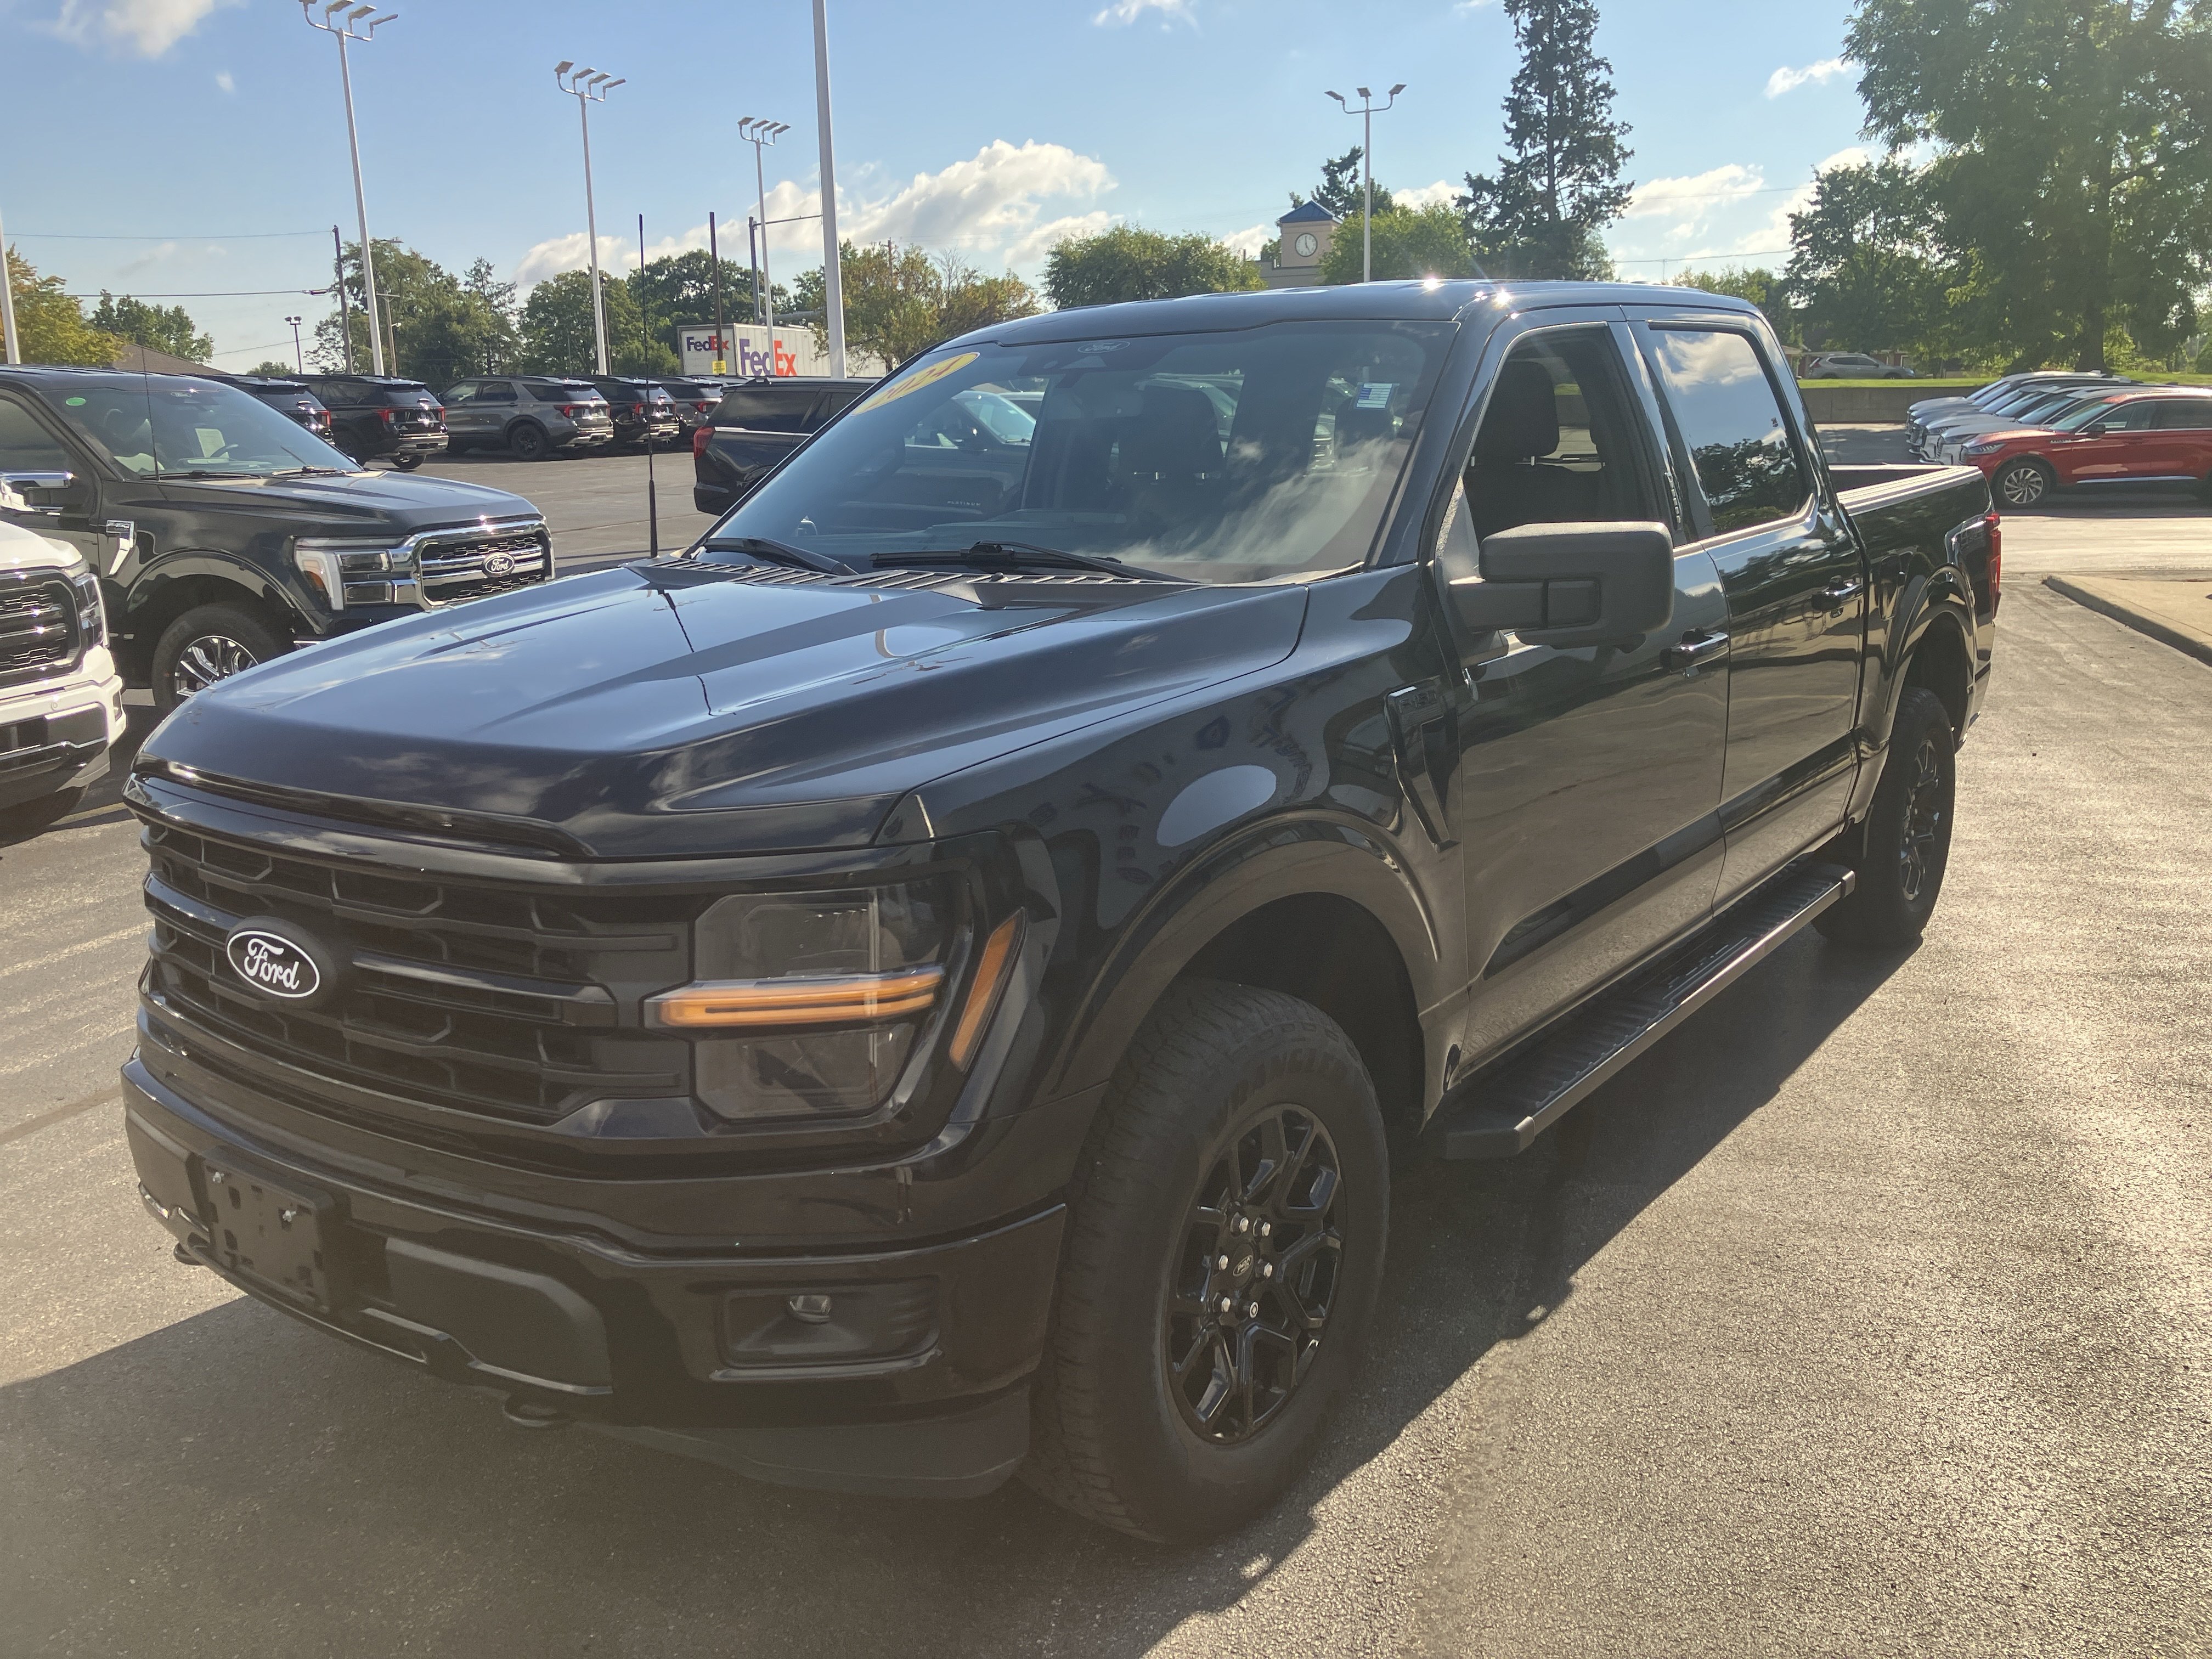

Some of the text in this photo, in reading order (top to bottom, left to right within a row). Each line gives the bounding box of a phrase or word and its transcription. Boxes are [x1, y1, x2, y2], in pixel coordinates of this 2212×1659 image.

[686, 336, 729, 351] FedEx
[491, 558, 509, 571] Ford
[244, 938, 300, 990] Ford
